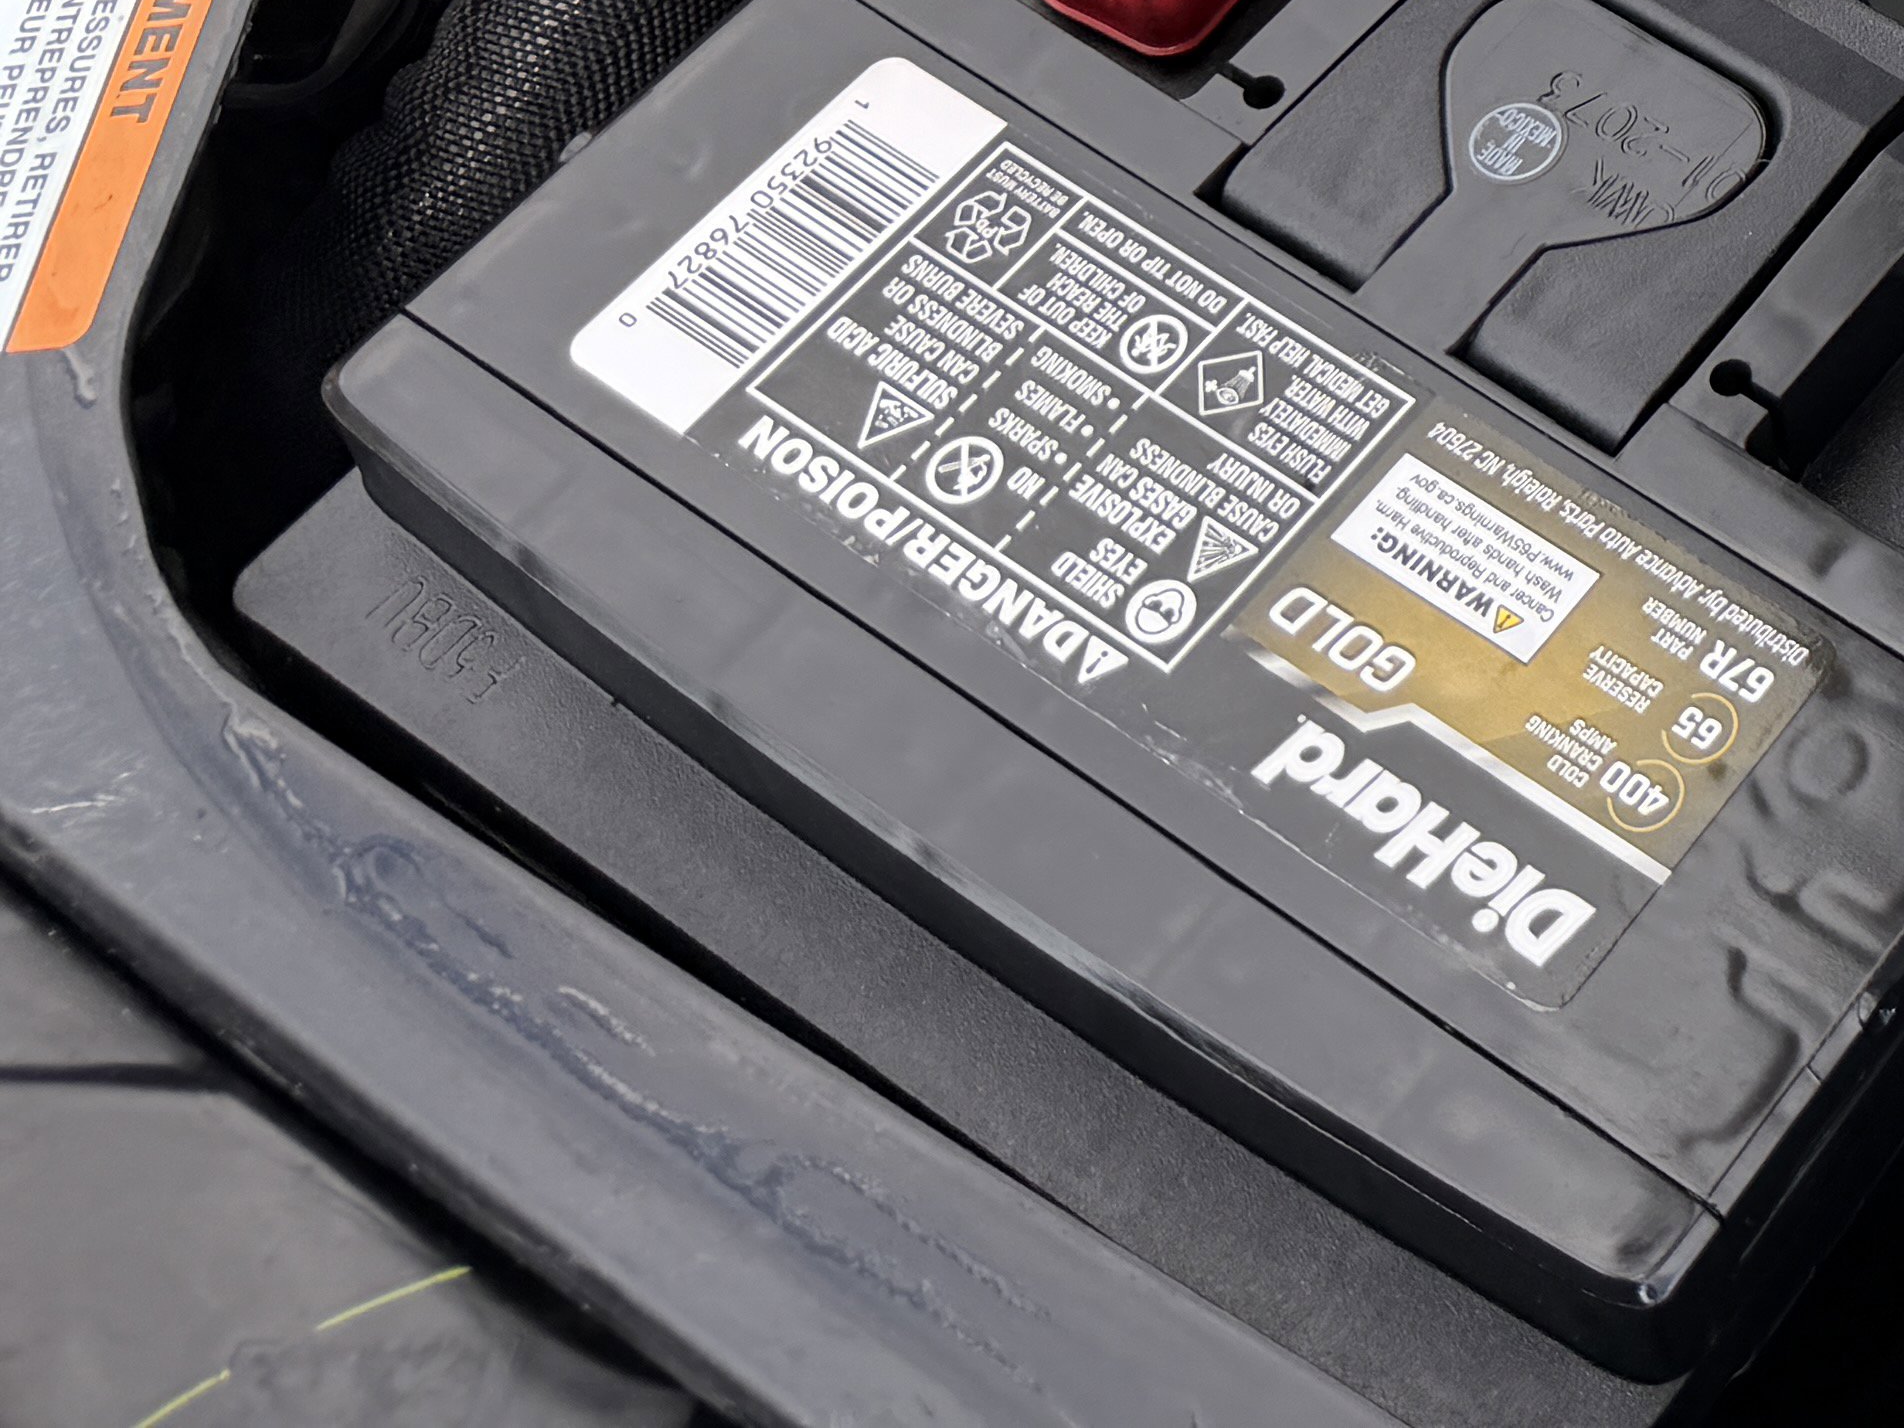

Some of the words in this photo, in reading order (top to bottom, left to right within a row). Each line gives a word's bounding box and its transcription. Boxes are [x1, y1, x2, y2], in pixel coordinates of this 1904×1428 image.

[1497, 108, 1557, 147] MEXICO
[1503, 134, 1526, 155] IN
[745, 134, 837, 210] 92350
[984, 166, 1019, 191] MUST
[997, 157, 1056, 197] RECYCLED
[1477, 140, 1523, 175] MADE
[1012, 184, 1062, 218] BATTERY
[1049, 190, 1070, 206] BE
[970, 216, 999, 239] Pb
[1072, 209, 1127, 249] OPEN.
[658, 211, 752, 290] 76827
[1043, 241, 1128, 300] CHILDREN.
[1116, 237, 1150, 264] OR
[1139, 252, 1173, 279] TIP
[879, 275, 917, 306] OR
[898, 252, 966, 301] BURNS
[1016, 280, 1048, 306] OF
[1045, 271, 1108, 316] REACH
[1163, 267, 1205, 299] NOT
[953, 288, 1026, 340] SEVERE
[1036, 294, 1078, 326] OUT
[1096, 303, 1131, 331] THE
[1117, 288, 1148, 314] OF
[1194, 287, 1229, 314] DO
[823, 313, 881, 357] ACID
[881, 313, 948, 362] CAUSE
[904, 292, 1004, 362] BLINDNESS
[1066, 312, 1114, 349] KEEP
[1233, 311, 1280, 347] FAST.
[934, 348, 982, 384] CAN
[1267, 332, 1312, 368] HELP
[865, 341, 960, 410] SULFURIC
[1027, 344, 1114, 406] SMOKING
[1278, 373, 1338, 418] WATER.
[1299, 353, 1366, 402] MEDICAL
[1012, 378, 1087, 432] FLAMES
[1326, 404, 1372, 440] WITH
[1353, 387, 1392, 419] GET
[984, 405, 1062, 462] SPARKS
[1245, 420, 1290, 456] EYES
[1257, 394, 1353, 462] IMMEDIATELY
[1426, 418, 1483, 462] 27604
[1004, 464, 1046, 499] NO
[1093, 451, 1142, 490] CAN
[1126, 436, 1227, 508] BLINDNESS
[1205, 449, 1276, 502] INJURY
[1277, 441, 1333, 484] FLUSH
[1473, 448, 1506, 476] NC
[1126, 474, 1200, 530] GASES
[1265, 488, 1303, 519] OR
[1388, 482, 1455, 531] handling.
[1495, 459, 1565, 513] Raleigh,
[1066, 473, 1178, 554] EXPLOSIVE
[1215, 493, 1281, 543] CAUSE
[1370, 498, 1412, 529] Harm.
[1405, 469, 1578, 585] www.P65Warnings.ca.gov
[1553, 496, 1607, 540] Parts,
[732, 413, 1093, 664] DANGER/POISON
[1405, 518, 1490, 579] Reproductive
[1447, 522, 1484, 551] after
[1595, 525, 1642, 563] Auto
[1047, 549, 1126, 609] SHIELD
[1085, 535, 1149, 585] EYES
[1364, 524, 1497, 618] WARNING:
[1478, 542, 1525, 578] hands
[1630, 547, 1703, 602] Advance
[1482, 570, 1512, 595] and
[1520, 569, 1565, 603] Wash
[1693, 583, 1731, 617] by:
[1507, 586, 1557, 624] Cancer
[1639, 595, 1707, 646] NUMBER
[1262, 577, 1422, 699] GOLD
[1649, 625, 1694, 661] PART
[1717, 601, 1810, 669] Distributed
[1580, 661, 1651, 714] RESERVE
[1588, 642, 1665, 698] CAPACITY
[1694, 637, 1778, 706] 67R
[1523, 712, 1605, 773] CRANKING
[1567, 717, 1618, 756] AMPS
[1669, 702, 1725, 752] 65
[1544, 752, 1591, 790] COLD
[1595, 757, 1674, 822] 400
